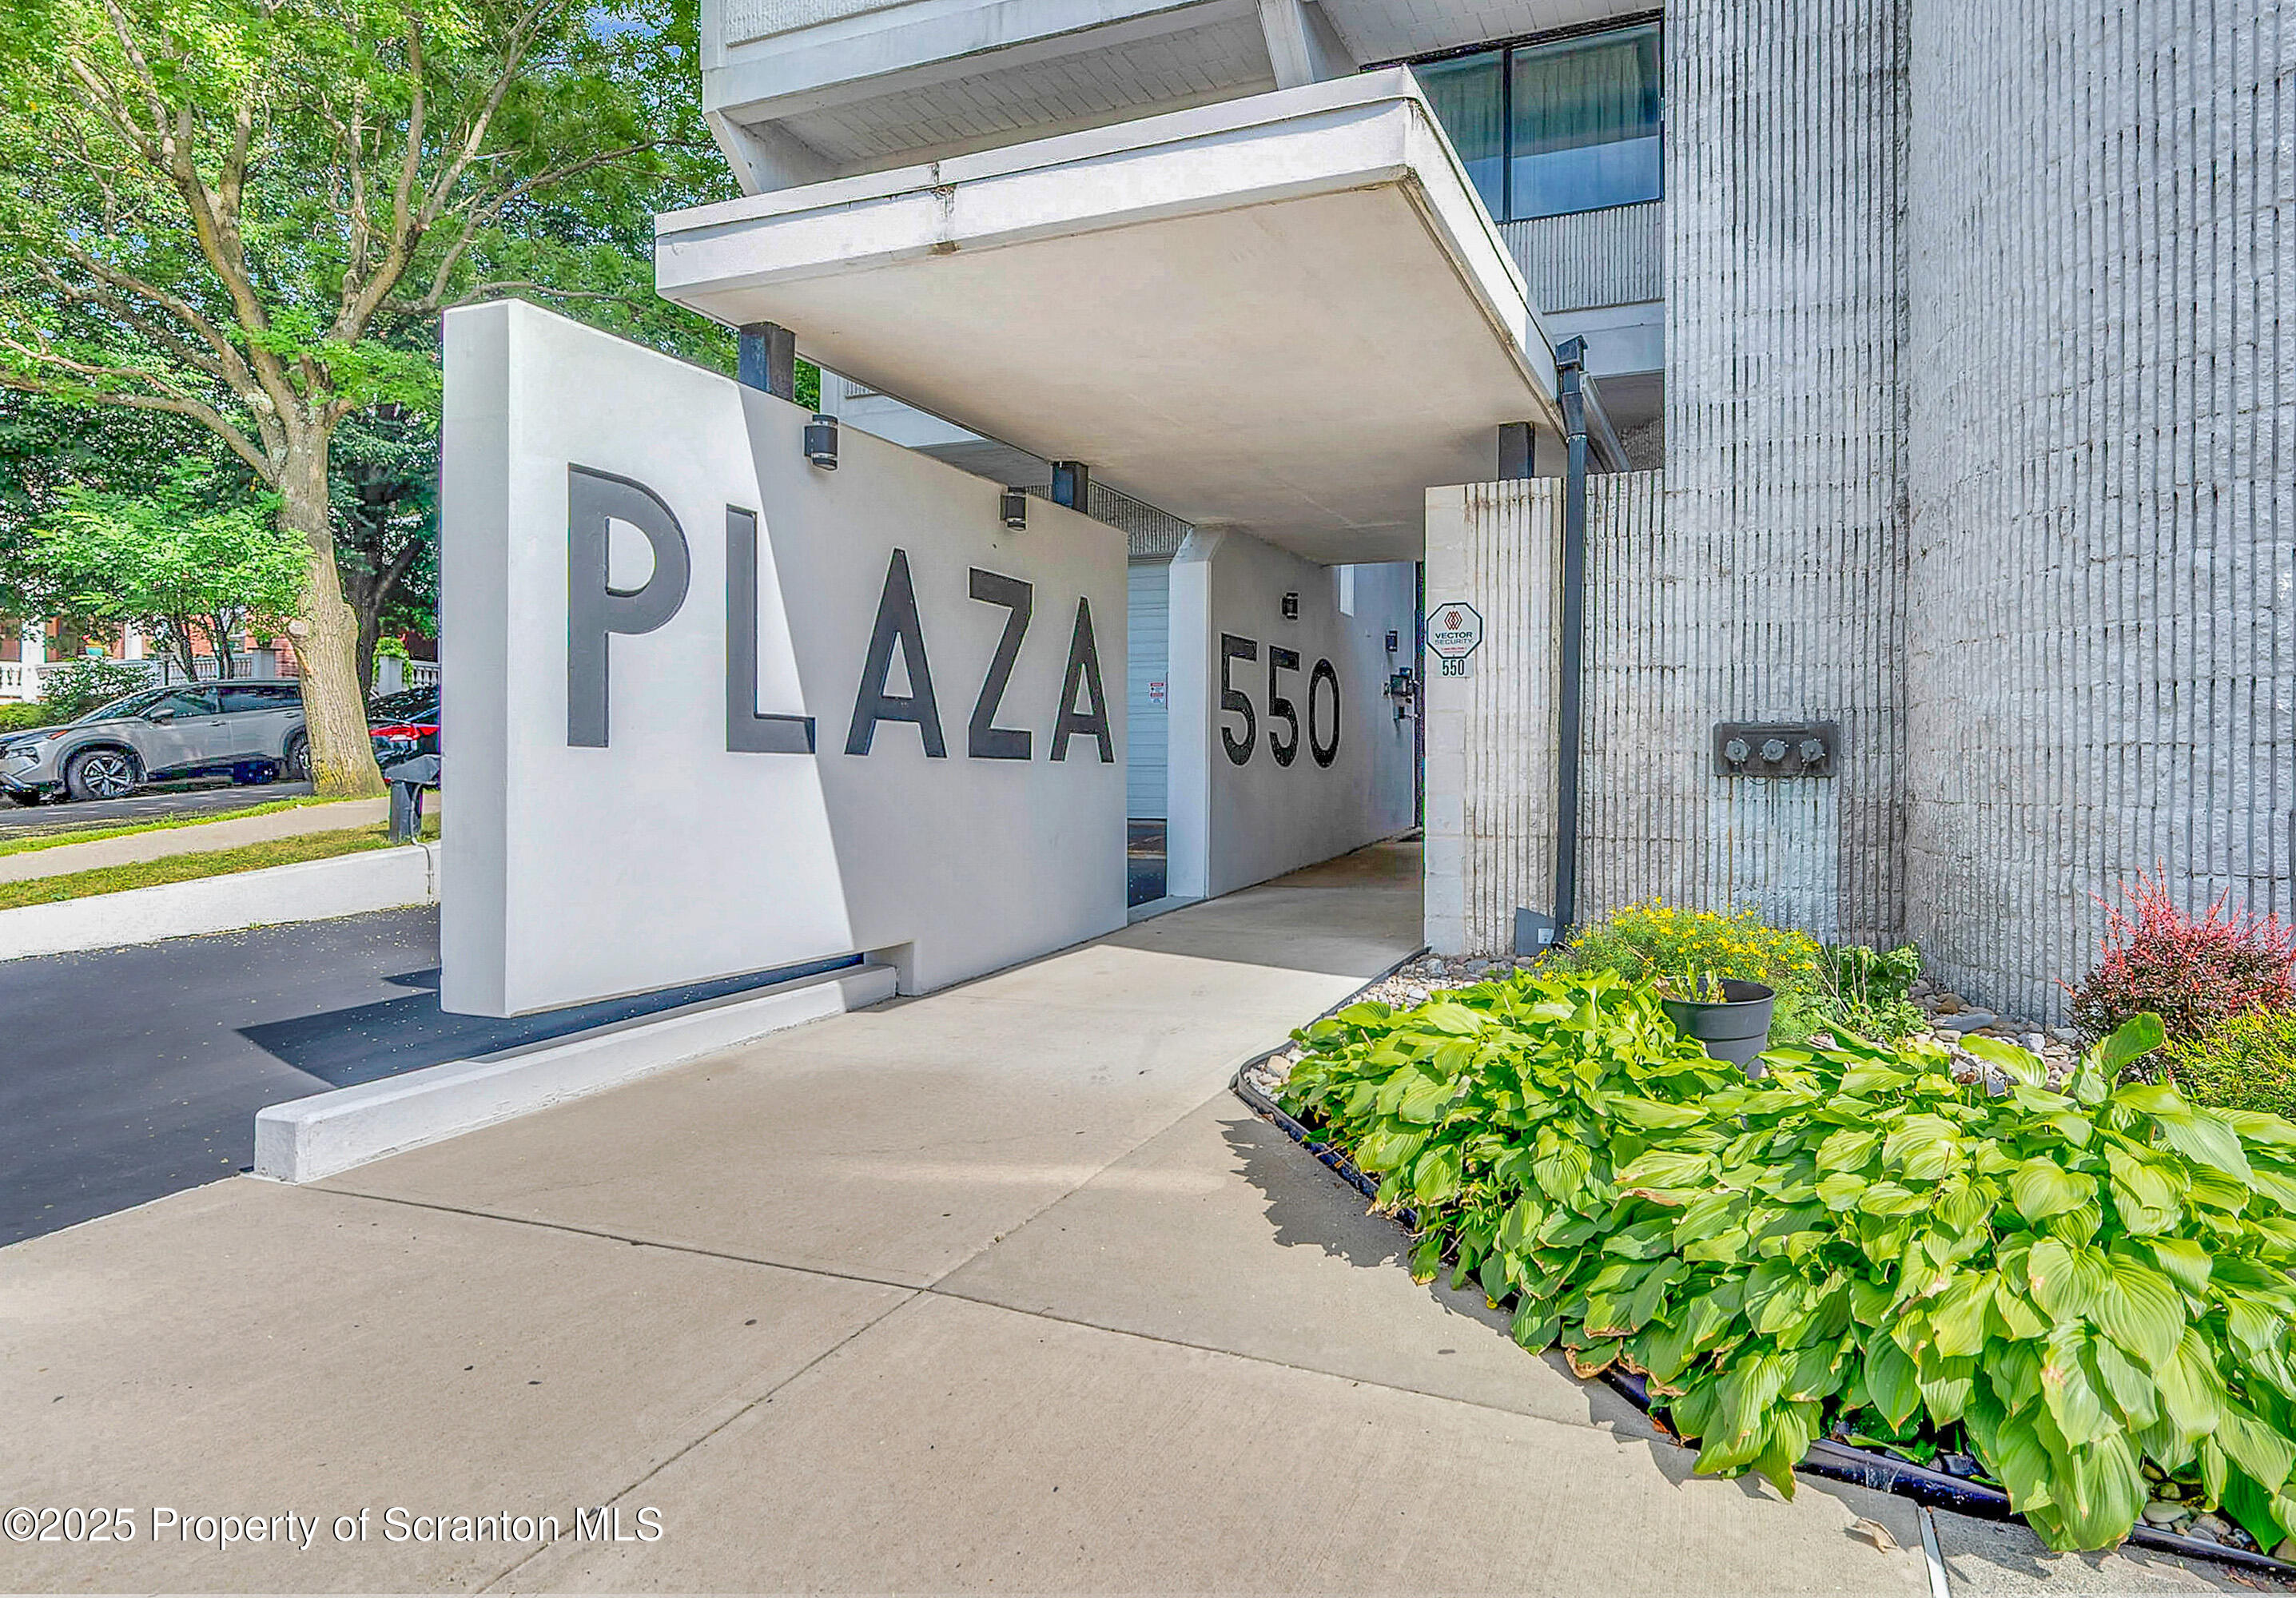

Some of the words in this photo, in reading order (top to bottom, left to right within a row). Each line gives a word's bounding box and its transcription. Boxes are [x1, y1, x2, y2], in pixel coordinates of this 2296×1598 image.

[567, 462, 1116, 764] PLAZA
[1442, 659, 1465, 676] 550
[1220, 632, 1341, 769] 550
